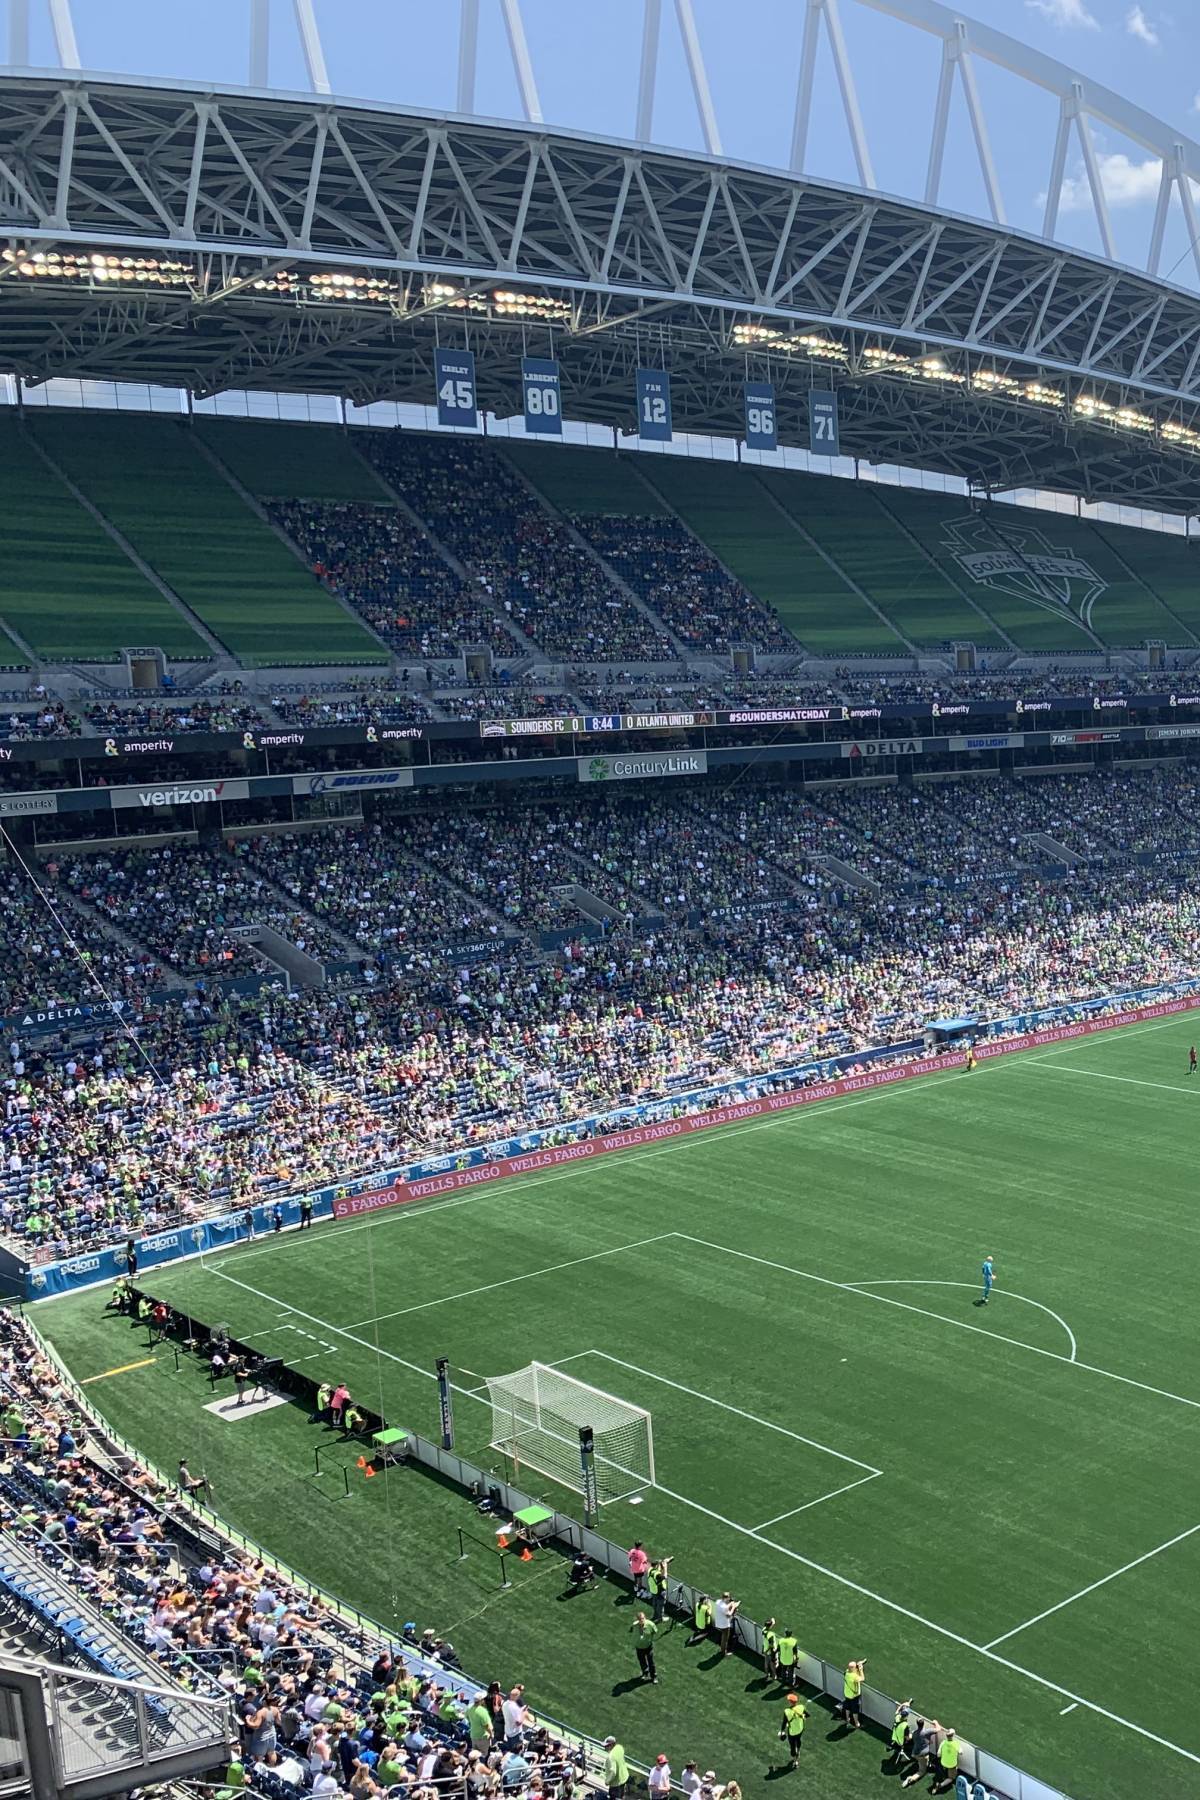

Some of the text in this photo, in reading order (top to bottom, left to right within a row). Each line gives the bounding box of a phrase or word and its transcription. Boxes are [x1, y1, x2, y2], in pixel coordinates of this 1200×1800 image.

[440, 380, 473, 409] 45
[527, 388, 557, 416] 80
[642, 397, 666, 423] 12
[748, 409, 774, 434] 96
[814, 416, 835, 440] 71
[972, 560, 1064, 575] SOUNERS
[940, 705, 970, 715] amperity
[1024, 702, 1051, 712] amperity
[1101, 699, 1127, 708] amperity
[511, 719, 553, 733] SOUNDERS
[554, 719, 565, 731] FC
[572, 718, 579, 731] 0
[592, 717, 613, 730] 8:44
[626, 716, 634, 728] 0
[636, 714, 668, 728] ATLANTA
[669, 713, 694, 725] UNITED
[729, 709, 830, 723] #SOUNDERSMATCHDAY
[850, 708, 882, 719] amperity
[260, 734, 304, 746] amperity
[382, 728, 422, 740] amperity
[967, 738, 1009, 749] BUD LIGHT
[125, 739, 174, 754] amperity
[866, 742, 917, 755] DELTA
[614, 757, 699, 776] CenturyLink
[331, 773, 401, 787] BOEING
[10, 800, 56, 810] LOTTERY
[139, 787, 217, 806] verizon
[37, 1007, 82, 1022] DELTA
[1141, 1002, 1187, 1019] WELLS FARGO
[1089, 1012, 1138, 1030] WELLS FARGO
[1034, 1025, 1085, 1044] WELLS FARGO
[974, 1039, 1030, 1060] WELLS FARGO
[909, 1055, 970, 1075] WELLS FARGO
[842, 1067, 906, 1090] WELLS FARGO
[768, 1086, 837, 1110] WELLS FARGO
[689, 1102, 762, 1129] WELLS FARGO
[602, 1122, 681, 1151] WELLS FARGO
[509, 1143, 595, 1174] WELLS FARGO
[407, 1175, 456, 1196] WELLS
[457, 1166, 501, 1186] FARGO
[350, 1190, 398, 1212] FARGO
[141, 1235, 178, 1252] slalom
[61, 1257, 99, 1275] slalom
[588, 1476, 597, 1514] SOUNDERS
